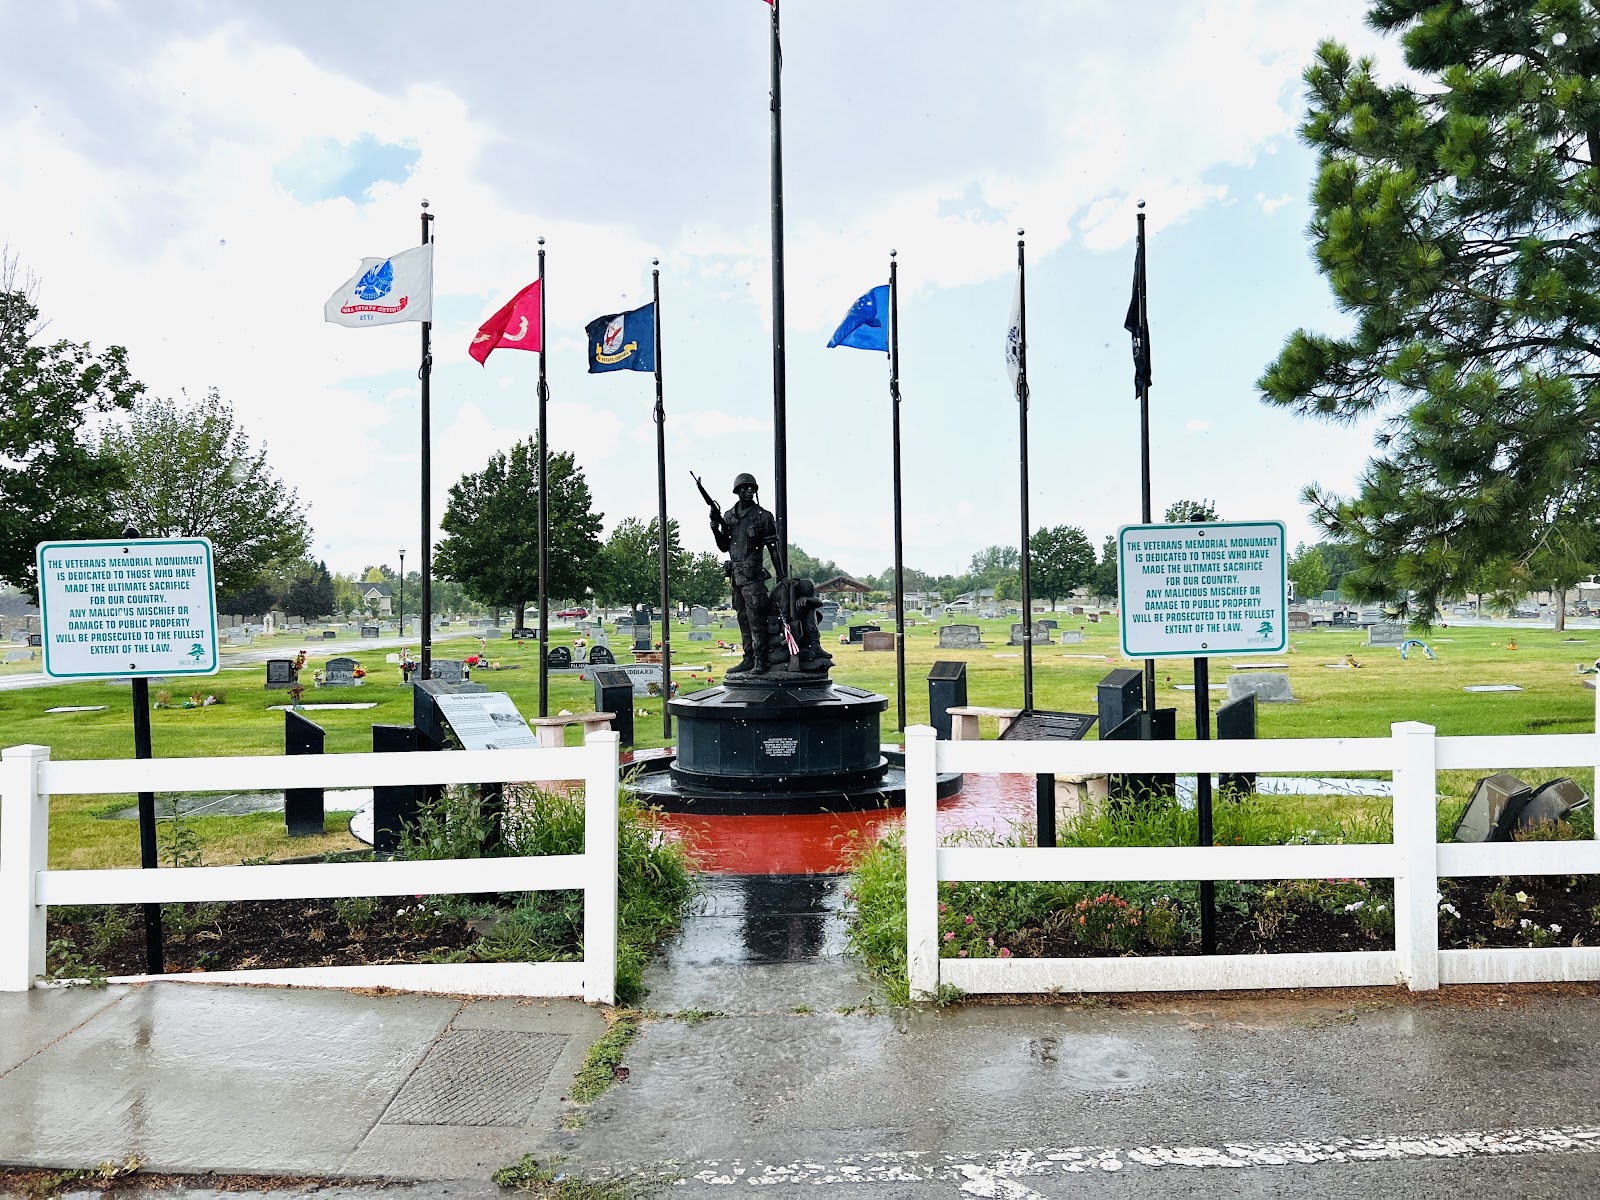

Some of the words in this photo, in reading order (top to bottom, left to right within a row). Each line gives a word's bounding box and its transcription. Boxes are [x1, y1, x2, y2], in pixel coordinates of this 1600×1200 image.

[1127, 542, 1141, 551] THE
[1144, 541, 1182, 550] VETERANS
[1185, 539, 1228, 549] MEMORIAL
[1230, 537, 1277, 547] MONUMENT
[1135, 554, 1143, 562] IS
[1146, 552, 1187, 562] DEDICATED
[1189, 552, 1199, 560] TO
[1201, 551, 1225, 560] THOSE
[1228, 550, 1247, 559] WHO
[1250, 549, 1269, 558] HAVE
[48, 560, 62, 568] THE
[65, 559, 106, 568] VETERANS
[109, 558, 153, 567] MEMORIAL
[156, 556, 203, 565] MONUMENT
[1142, 565, 1165, 574] MADE
[1167, 564, 1181, 573] THE
[1184, 563, 1220, 573] ULTIMATE
[1223, 562, 1263, 571] SACRIFICE
[57, 572, 65, 580] IS
[68, 571, 111, 580] DEDICATED
[114, 571, 123, 579] TO
[126, 570, 151, 578] THOSE
[154, 569, 173, 578] WHO
[176, 569, 195, 577] HAVE
[1166, 577, 1180, 585] FOR
[1183, 576, 1198, 585] OUR
[1202, 575, 1239, 584] COUNTRY.
[65, 584, 88, 592] MADE
[91, 584, 105, 592] THE
[108, 582, 146, 591] ULTIMATE
[149, 581, 190, 590] SACRIFICE
[1146, 590, 1162, 598] ANY
[1165, 588, 1207, 597] MALICIOUS
[1210, 587, 1247, 596] MISCHIEF
[1250, 586, 1260, 595] OR
[90, 596, 105, 604] FOR
[108, 596, 124, 604] OUR
[127, 595, 166, 603] COUNTRY.
[1145, 601, 1178, 610] DAMAGE
[1180, 600, 1190, 609] TO
[1193, 600, 1219, 608] PUBLIC
[1223, 598, 1261, 607] PROPERTY
[70, 609, 86, 617] ANY
[137, 607, 175, 615] MISCHIEF
[178, 606, 188, 614] OR
[1133, 614, 1152, 623] WILL
[1154, 613, 1163, 622] BE
[1166, 612, 1214, 621] PROSECUTED
[1217, 611, 1226, 620] TO
[1228, 611, 1242, 619] THE
[1245, 610, 1274, 619] FULLEST
[69, 621, 103, 630] DAMAGE
[106, 621, 115, 629] TO
[119, 620, 147, 628] PUBLIC
[150, 618, 189, 627] PROPERTY
[1165, 625, 1192, 634] EXTENT
[1195, 624, 1204, 633] OF
[1207, 624, 1220, 632] THE
[1223, 623, 1242, 632] LAW.
[56, 634, 76, 642] WILL
[79, 634, 88, 642] BE
[91, 632, 141, 641] PROSECUTED
[144, 632, 154, 640] TO
[156, 631, 171, 639] THE
[174, 630, 204, 639] FULLEST
[91, 645, 119, 654] EXTENT
[122, 645, 131, 653] OF
[134, 644, 148, 653] THE
[152, 644, 172, 652] LAW.
